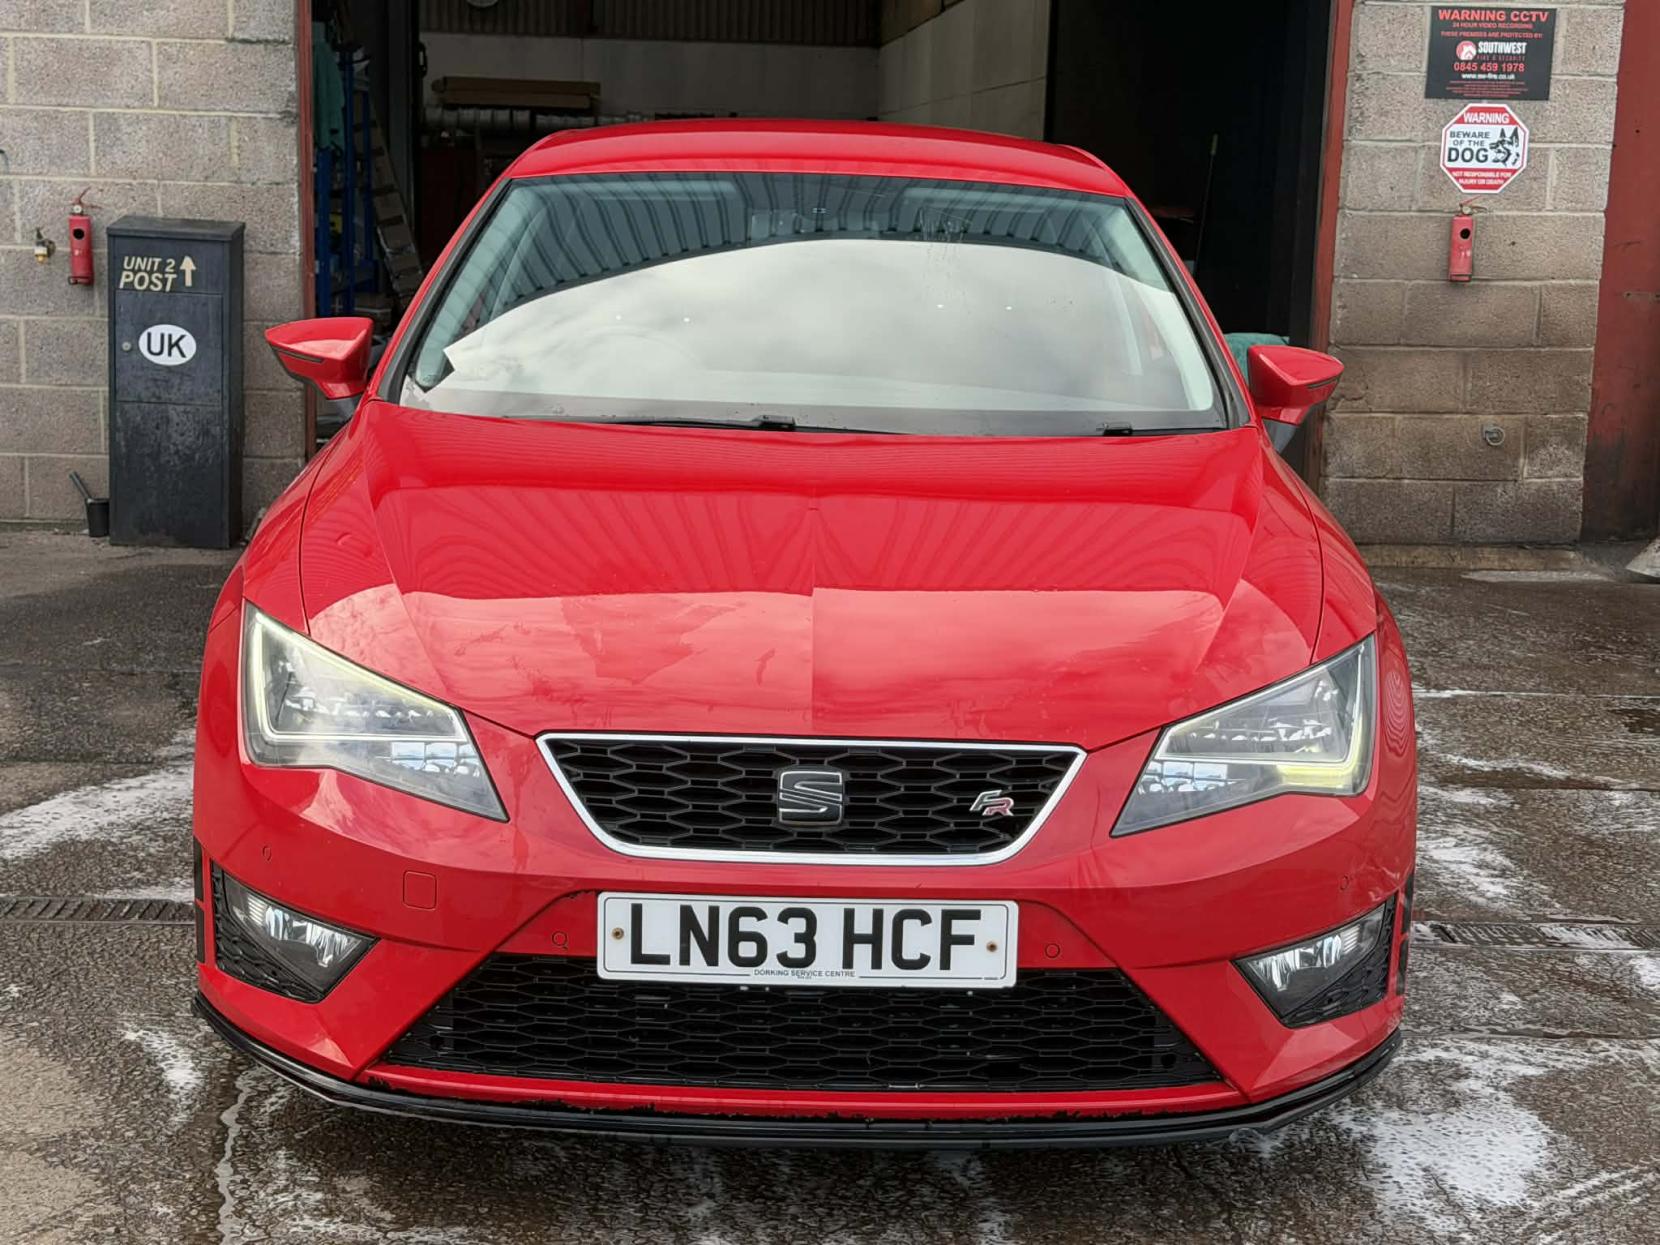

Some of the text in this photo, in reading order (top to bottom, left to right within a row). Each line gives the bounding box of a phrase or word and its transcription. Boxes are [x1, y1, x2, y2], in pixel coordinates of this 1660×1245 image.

[1438, 9, 1549, 22] WARNING CCTV
[1478, 41, 1527, 54] SOUTHWEST
[1453, 62, 1525, 72] 0845 459 1978
[1463, 112, 1510, 124] WARNING
[1449, 131, 1490, 139] BEWARE
[1447, 147, 1489, 163] DOG
[123, 256, 176, 272] UNIT 2
[119, 271, 177, 292] POST
[147, 332, 187, 358] UK
[969, 789, 1014, 816] FR
[631, 903, 981, 970] LN63 HCF
[791, 969, 823, 977] SERVICE
